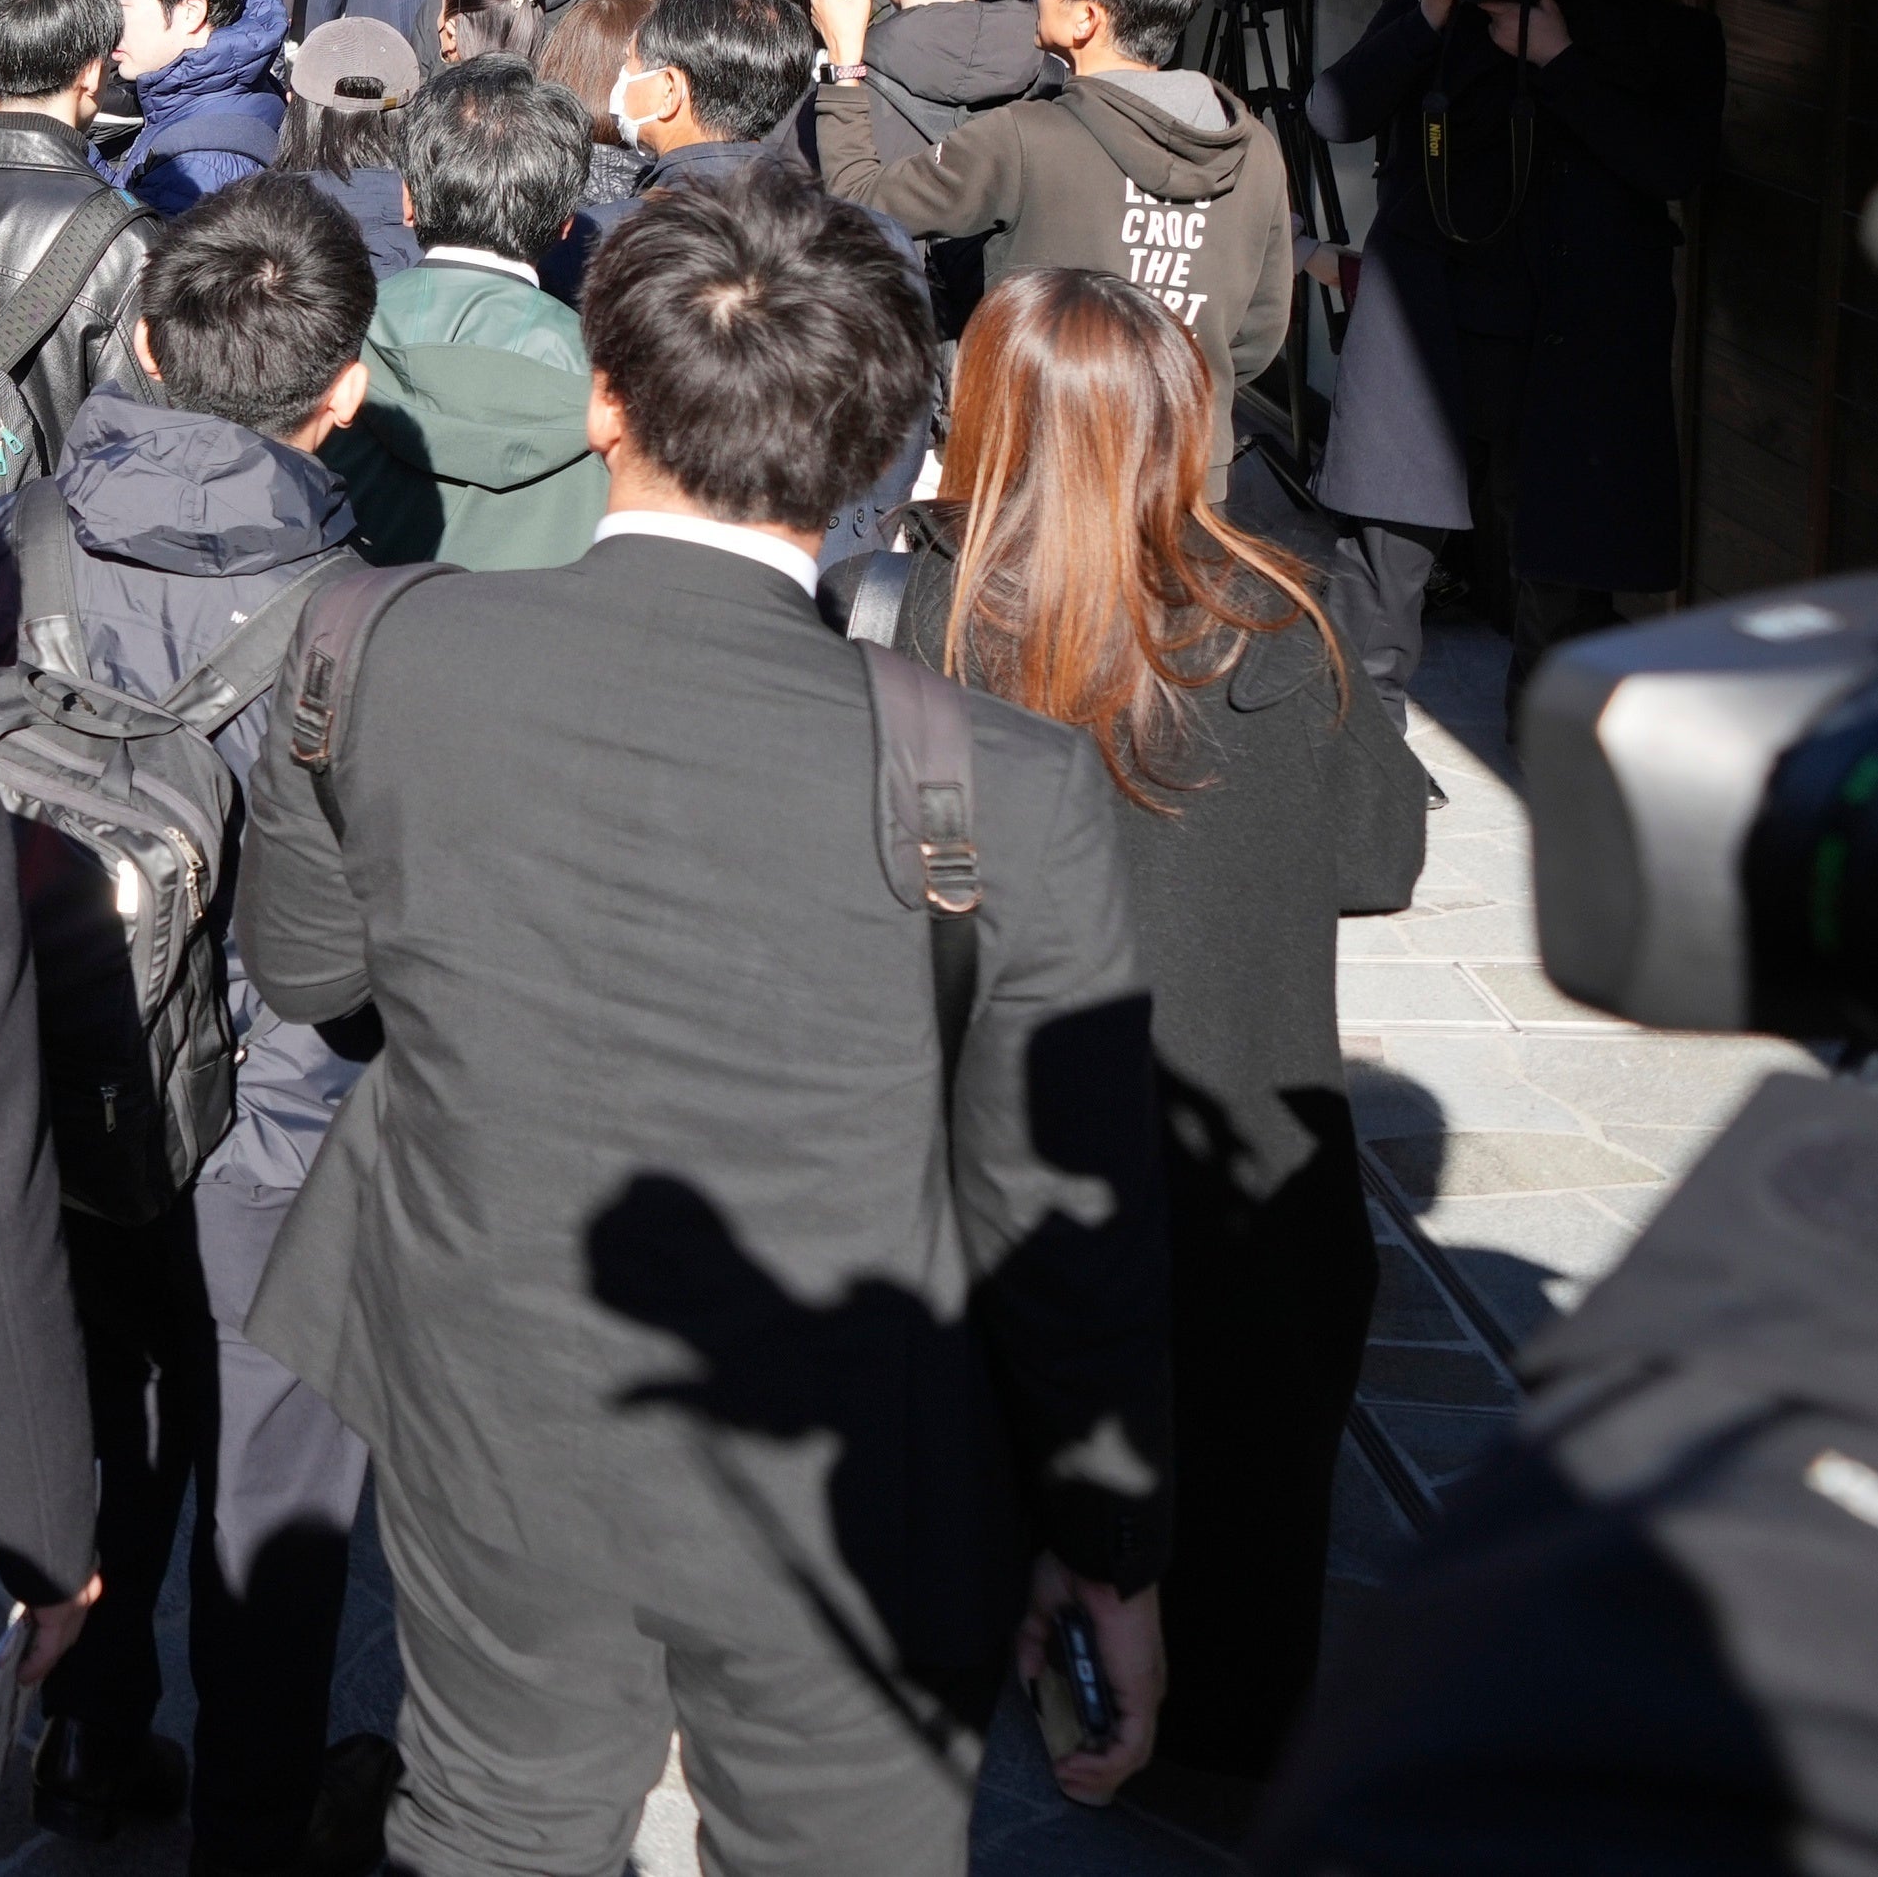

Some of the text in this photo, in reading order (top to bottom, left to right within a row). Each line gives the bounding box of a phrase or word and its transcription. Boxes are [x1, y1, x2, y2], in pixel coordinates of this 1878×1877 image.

[1428, 123, 1441, 157] Nikon
[1121, 208, 1206, 249] CROC
[1129, 248, 1191, 287] THE
